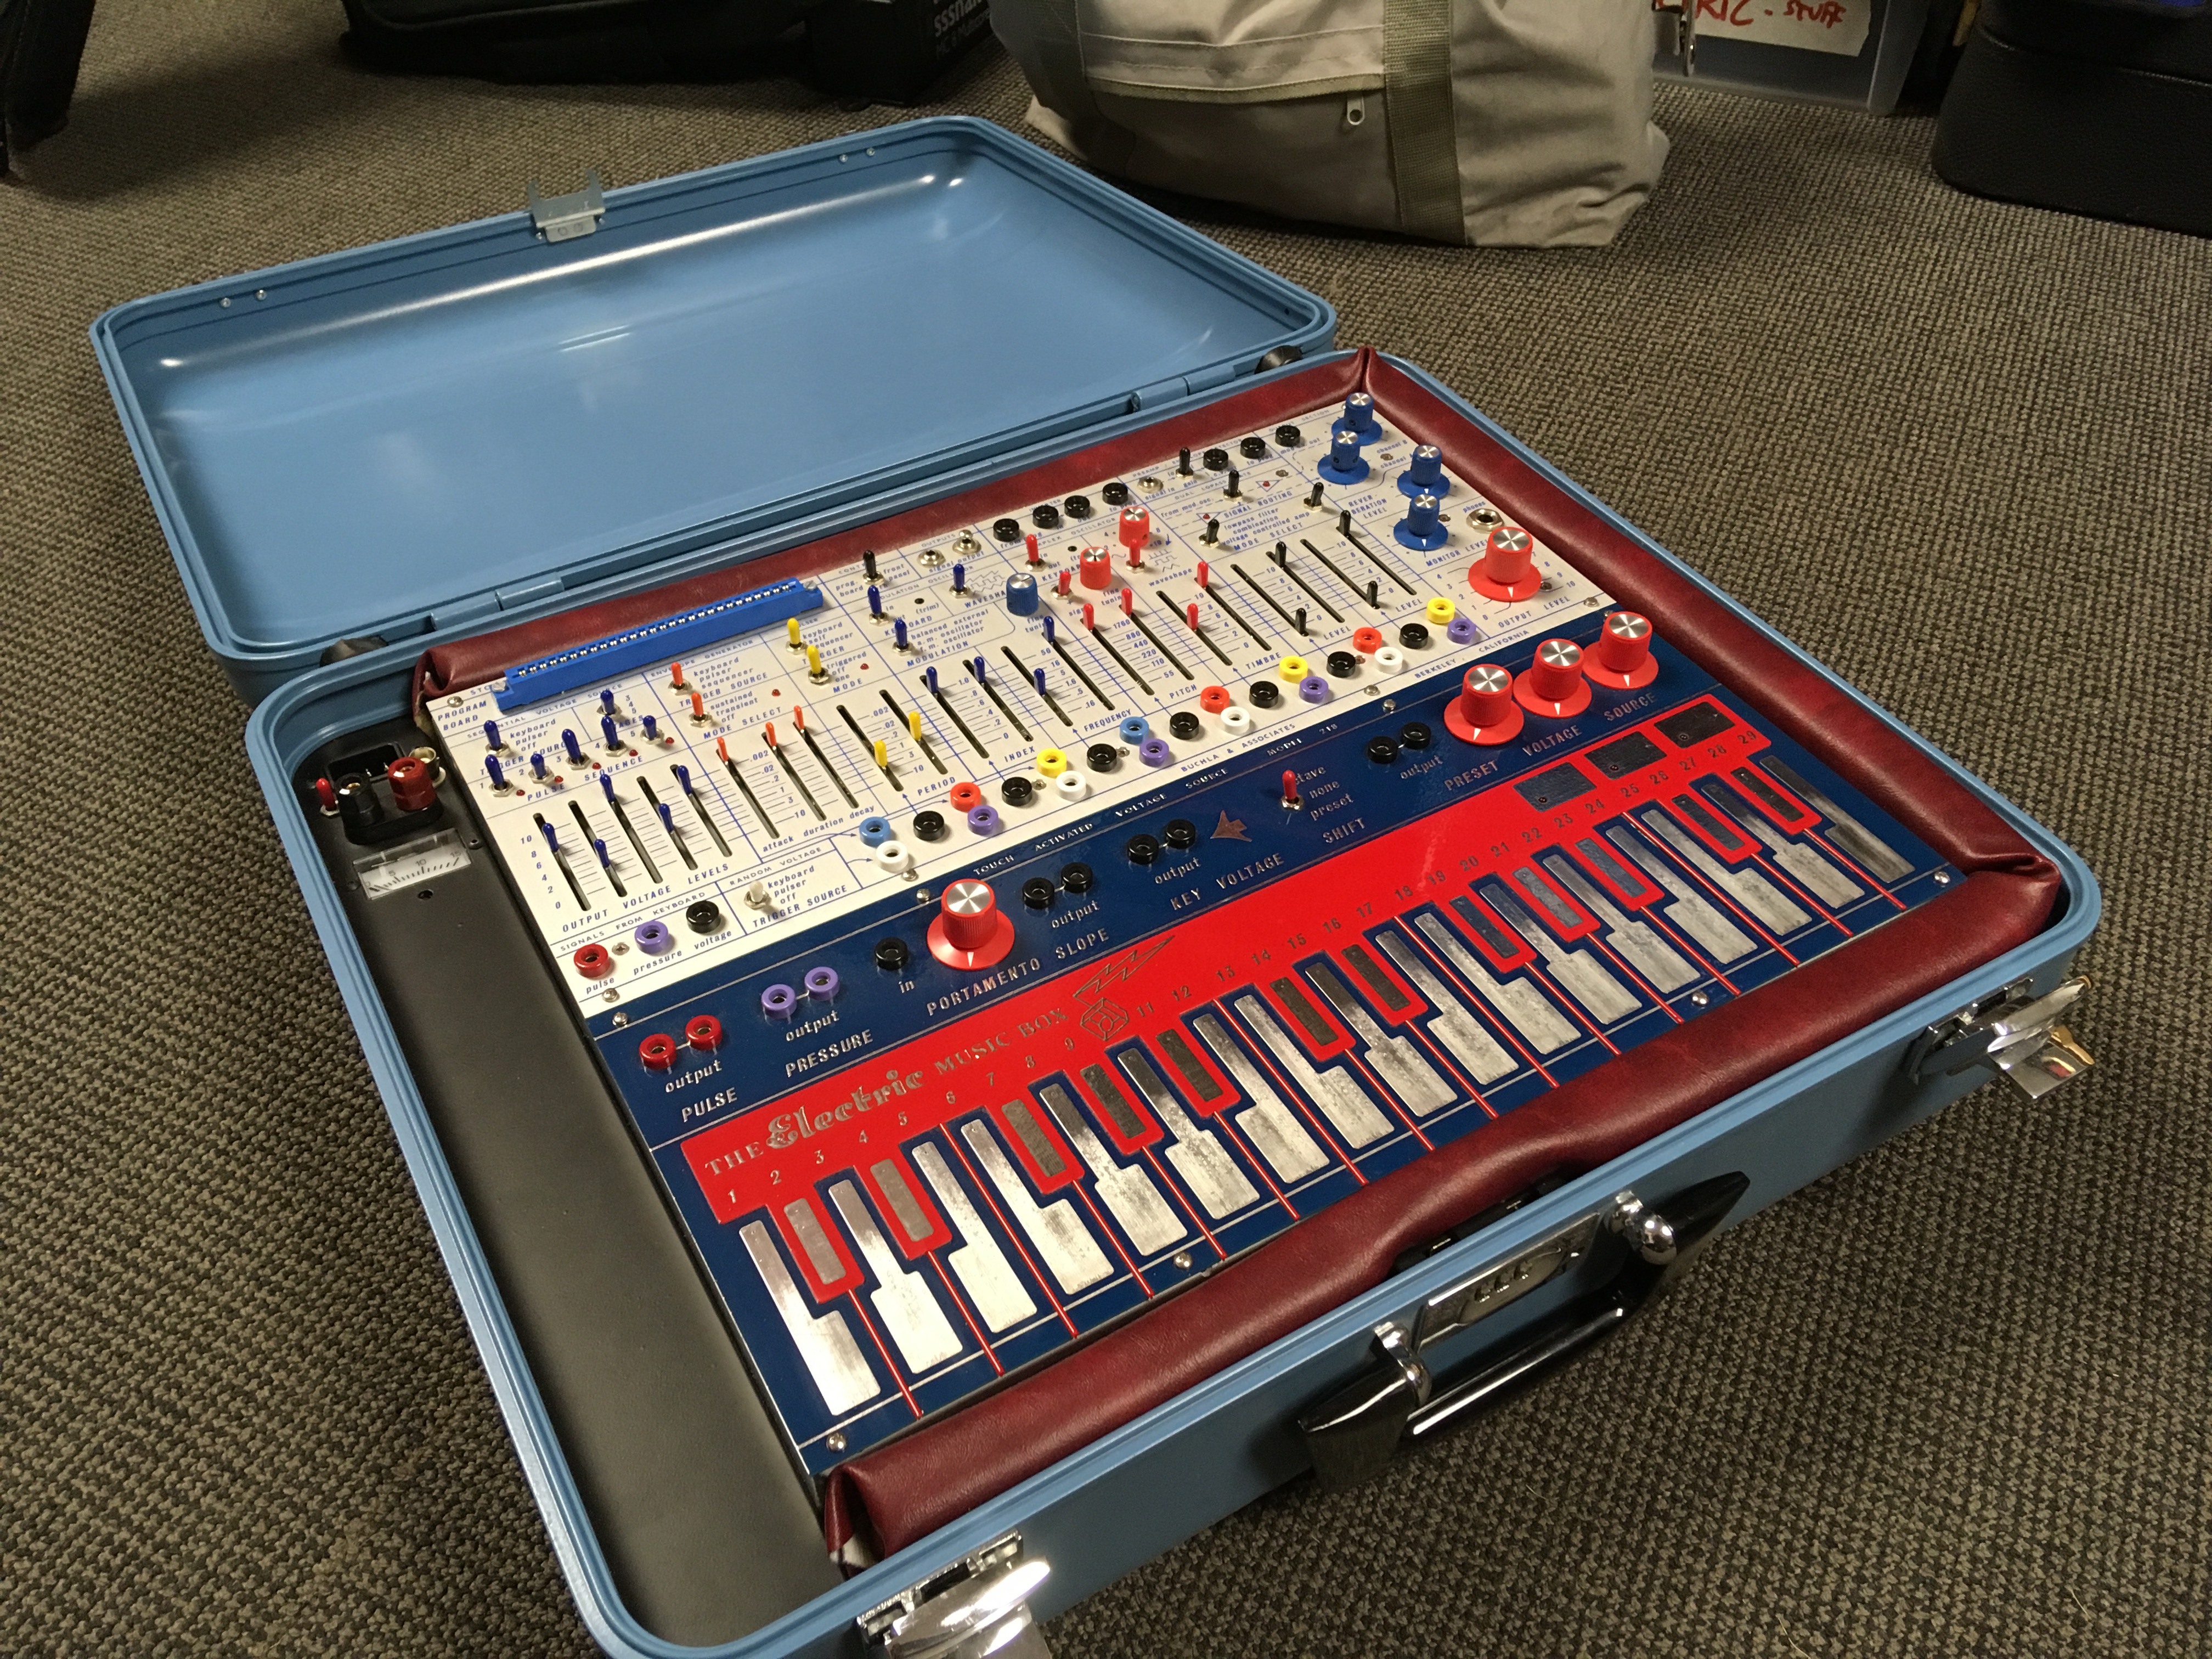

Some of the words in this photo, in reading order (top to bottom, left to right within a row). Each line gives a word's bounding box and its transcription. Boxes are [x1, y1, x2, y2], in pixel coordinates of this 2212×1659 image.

[1377, 444, 1398, 454] channel
[1133, 466, 1159, 478] PREAMP
[1381, 458, 1407, 469] channel
[1224, 505, 1252, 518] SIGNAL
[1259, 492, 1293, 506] ROUTING
[1351, 499, 1387, 515] BERATION
[1364, 507, 1387, 520] LEVEL
[1463, 501, 1486, 513] phones
[1071, 518, 1116, 534] OSCILLATOR
[1224, 519, 1255, 531] lowpass
[1259, 508, 1278, 518] filter
[1233, 516, 1278, 534] combination
[1222, 533, 1248, 546] voltage
[1253, 518, 1290, 540] controlled
[1294, 512, 1310, 522] amp
[1234, 539, 1260, 551] MODE
[1270, 522, 1303, 538] SELECT
[929, 561, 953, 573] signal
[1426, 550, 1460, 567] MONITOR
[883, 564, 904, 574] front
[889, 570, 910, 582] panel
[1149, 568, 1192, 586] waveshape
[840, 585, 863, 597] board
[1396, 599, 1423, 613] LEVEL
[1499, 611, 1532, 628] OUTPUT
[1544, 596, 1570, 610] LEVEL
[803, 622, 842, 640] keyboard
[911, 623, 947, 640] balanced
[953, 610, 989, 625] external
[940, 620, 983, 637] oscillator
[1324, 626, 1351, 640] LEVEL
[809, 634, 826, 645] self
[944, 627, 984, 644] oscillator
[1126, 631, 1140, 640] 880
[1133, 640, 1148, 648] 440
[704, 640, 753, 659] GENERATOR
[907, 641, 969, 667] MODULATION
[1142, 650, 1156, 659] 220
[1414, 658, 1457, 679] BERKELEY
[1479, 629, 1530, 653] CALIFORNIA
[693, 657, 739, 677] keyboard
[827, 652, 866, 670] triggered
[1152, 659, 1164, 667] 110
[1246, 652, 1282, 669] TIMBRE
[699, 667, 732, 682] pulser
[702, 668, 753, 689] sequencer
[832, 667, 845, 675] off
[835, 674, 849, 683] one
[1164, 670, 1174, 679] 55
[730, 672, 768, 690] SOURCE
[833, 679, 862, 693] MODE
[710, 691, 753, 710] sustained
[1170, 685, 1197, 699] PITCH
[438, 701, 487, 721] PROGRAM
[716, 698, 758, 716] transient
[443, 714, 478, 730] BOARD
[467, 716, 526, 738] SEQNTIAL
[537, 698, 576, 715] VOLTAGE
[704, 725, 732, 739] MODE
[742, 707, 782, 725] SELECT
[721, 713, 735, 723] off
[1084, 709, 1131, 731] FREQUENCY
[510, 719, 556, 738] keyboard
[515, 730, 548, 746] pulser
[521, 742, 537, 752] off
[1444, 760, 1499, 791] PRESET
[1522, 725, 1582, 757] VOLTAGE
[1604, 692, 1656, 721] SOURCE
[1005, 746, 1035, 762] INDEX
[1181, 754, 1218, 772] BUCHLA
[1242, 723, 1296, 749] ASSOCIATES
[913, 765, 924, 773] 10
[1401, 755, 1443, 780] output
[527, 783, 565, 801] PULSE
[584, 755, 643, 781] SEQUENCE
[917, 777, 956, 795] PERIOD
[1309, 779, 1339, 799] none
[973, 855, 1014, 876] TOUCH
[1035, 823, 1093, 851] ACTIVATED
[1115, 793, 1167, 817] VOLTAGE
[1185, 768, 1228, 789] SOURCE
[1267, 738, 1302, 757] MODEL
[1319, 723, 1338, 735] 218
[1310, 793, 1353, 821] preset
[763, 836, 794, 851] attack
[803, 817, 843, 836] duration
[849, 805, 875, 819] decay
[1322, 817, 1365, 844] SHIFT
[730, 867, 771, 885] RANDOM
[780, 847, 822, 865] VOLTAGE
[1137, 1002, 1155, 1018] 11
[1172, 985, 1192, 1001] 12
[1216, 966, 1235, 981] 13
[1252, 950, 1271, 965] 14
[1288, 933, 1307, 949] 15
[1323, 918, 1341, 933] 16
[1357, 902, 1373, 918] 17
[1395, 885, 1413, 900] 18
[1427, 871, 1446, 884] 19
[1459, 855, 1479, 871] 20
[1491, 842, 1510, 857] 21
[1521, 827, 1542, 843] 22
[1554, 813, 1573, 828] 23
[1585, 798, 1605, 815] 24
[1621, 783, 1640, 799] 25
[1649, 770, 1669, 787] 26
[1679, 757, 1696, 771] 27
[1707, 744, 1727, 758] 28
[1737, 731, 1757, 744] 29
[1155, 857, 1201, 884] output
[768, 866, 815, 889] keyboard
[1170, 888, 1202, 910] KEY
[1216, 853, 1284, 889] VOLTAGE
[774, 879, 806, 898] pulser
[563, 910, 608, 932] OUTPUT
[623, 885, 671, 909] VOLTAGE
[688, 864, 729, 884] LEVELS
[753, 904, 800, 928] TRIGGER
[807, 885, 847, 906] SOURCE
[780, 893, 796, 905] off
[561, 931, 604, 951] SIGNALS
[616, 916, 642, 930] FROM
[653, 892, 705, 915] KEYBOARD
[1051, 900, 1100, 928] output
[633, 950, 682, 975] pressure
[694, 930, 732, 950] voltage
[927, 958, 1041, 1015] PORTAMENTO
[1055, 928, 1109, 959] SLOPE
[586, 977, 614, 994] pulse
[898, 980, 915, 994] in
[786, 1010, 839, 1041] output
[785, 1029, 873, 1077] PRESSURE
[665, 1059, 722, 1093] output
[704, 1141, 764, 1176] THE
[766, 1069, 926, 1149] Electric
[934, 1030, 1012, 1075] MUSIC
[1017, 1007, 1070, 1038] BOX
[681, 1087, 737, 1122] PULSE
[728, 1189, 736, 1203] 1
[770, 1170, 782, 1185] 2
[814, 1149, 825, 1164] 3
[859, 1130, 868, 1143] 4
[898, 1111, 908, 1126] 5
[946, 1091, 956, 1104] 6
[986, 1071, 995, 1086] 7
[1026, 1055, 1036, 1068] 8
[1065, 1037, 1075, 1050] 9
